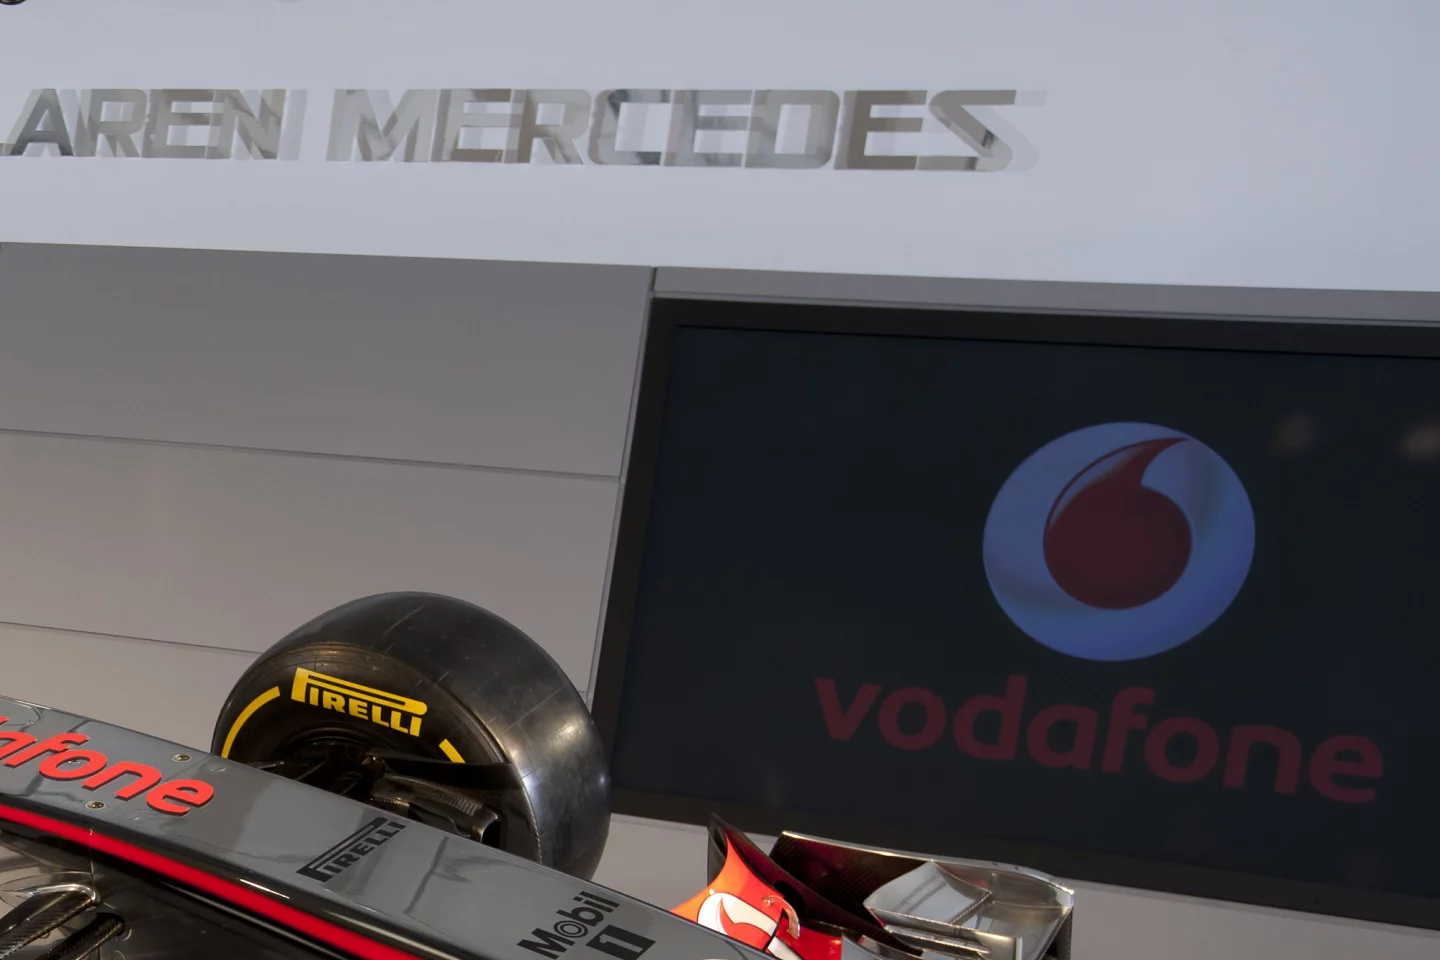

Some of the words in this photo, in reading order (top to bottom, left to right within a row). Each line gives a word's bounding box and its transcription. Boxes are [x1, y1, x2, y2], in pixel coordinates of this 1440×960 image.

[326, 88, 1017, 173] MERCEDES
[291, 667, 427, 737] PIRELLI
[814, 675, 1384, 804] vodafone
[295, 816, 408, 884] PIRELLI
[516, 890, 621, 960] Mobil
